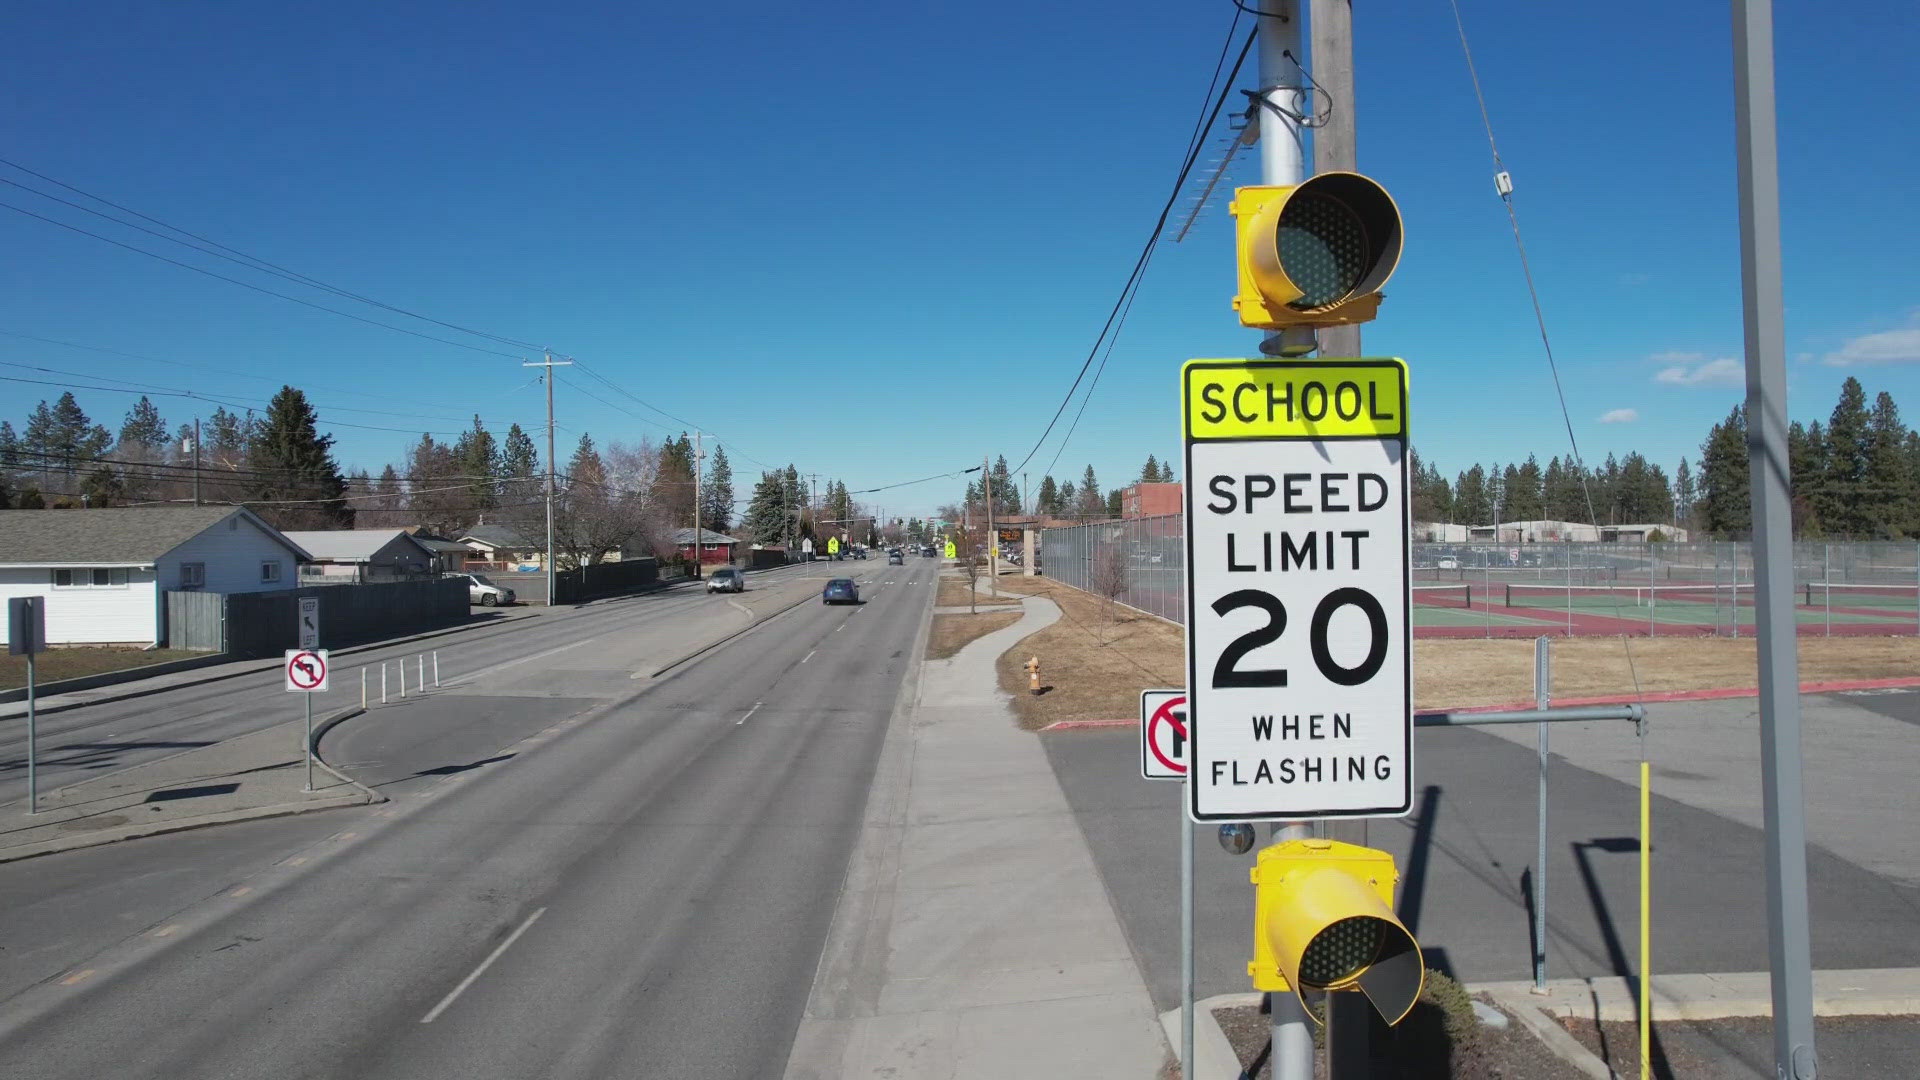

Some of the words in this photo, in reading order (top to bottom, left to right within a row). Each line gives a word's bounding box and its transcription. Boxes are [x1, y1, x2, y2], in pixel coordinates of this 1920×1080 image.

[1202, 381, 1394, 424] SCHOOL
[1207, 473, 1389, 515] SPEED
[1228, 531, 1370, 572] LIMIT
[302, 601, 316, 612] KEEP
[303, 634, 316, 645] LEFT
[1211, 587, 1389, 689] 20
[1252, 713, 1351, 741] WHEN
[1212, 755, 1391, 787] FLASHING
